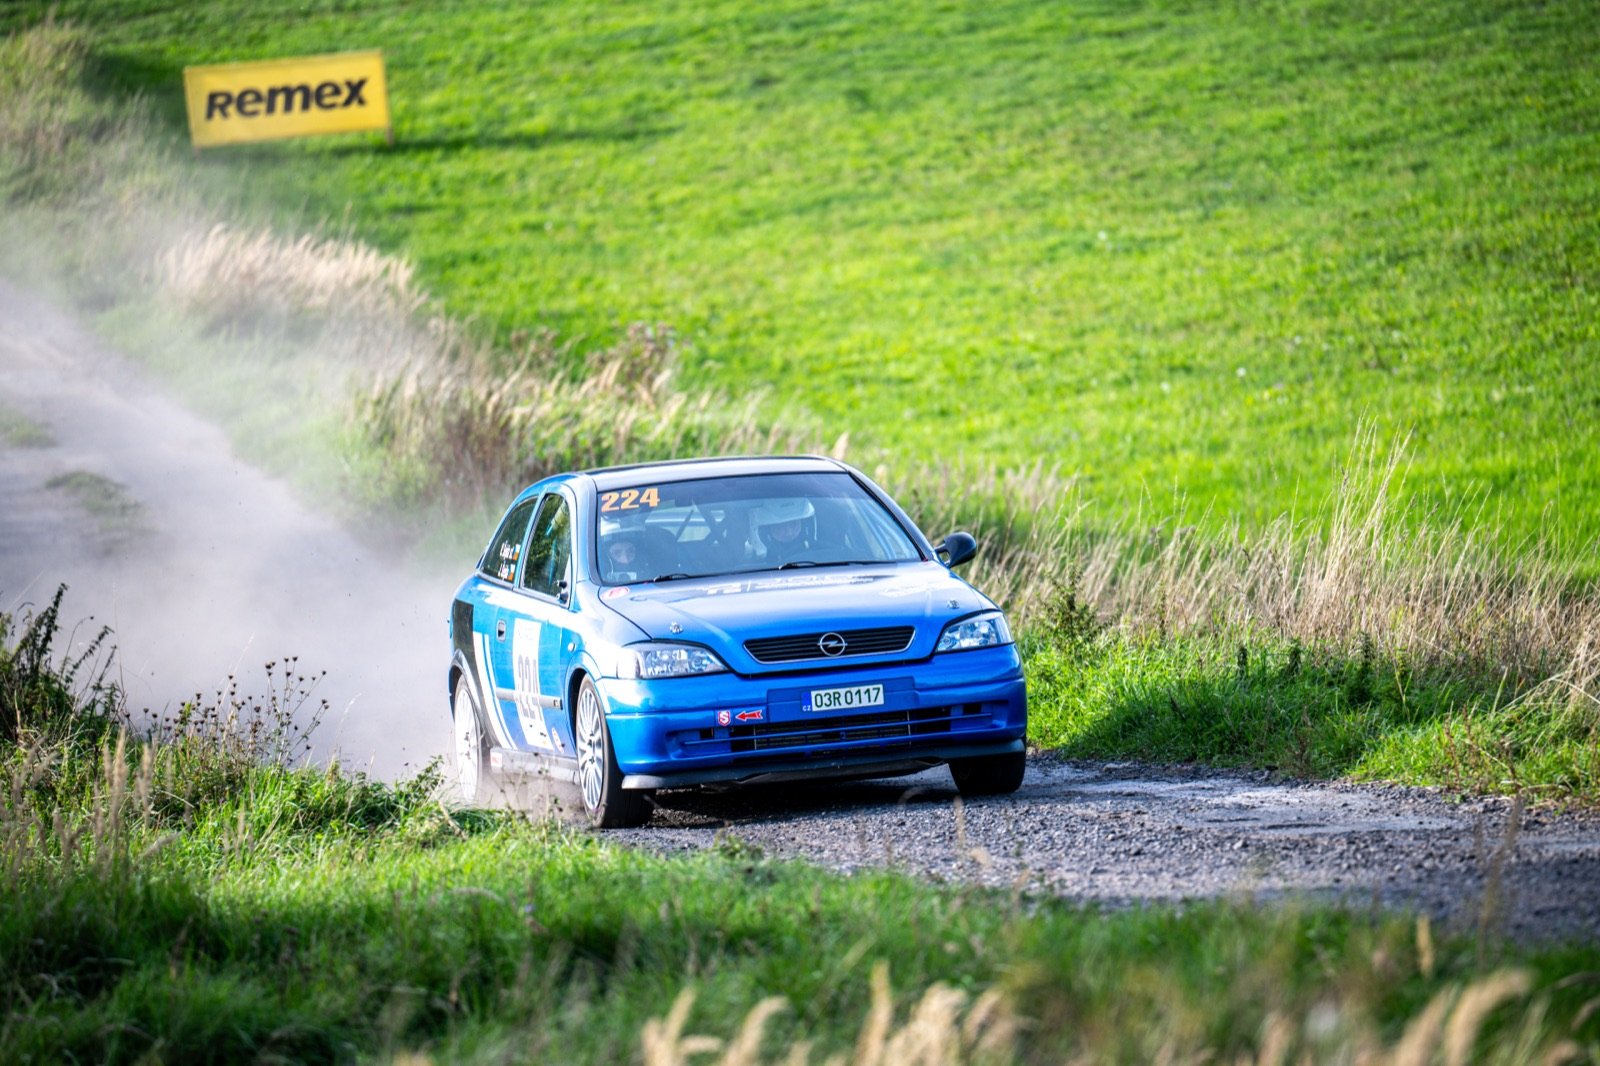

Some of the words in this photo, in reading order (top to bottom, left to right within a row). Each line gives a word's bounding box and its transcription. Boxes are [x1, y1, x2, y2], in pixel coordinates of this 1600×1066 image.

[205, 77, 368, 120] Remex
[601, 487, 660, 513] 224
[802, 704, 812, 712] CZ
